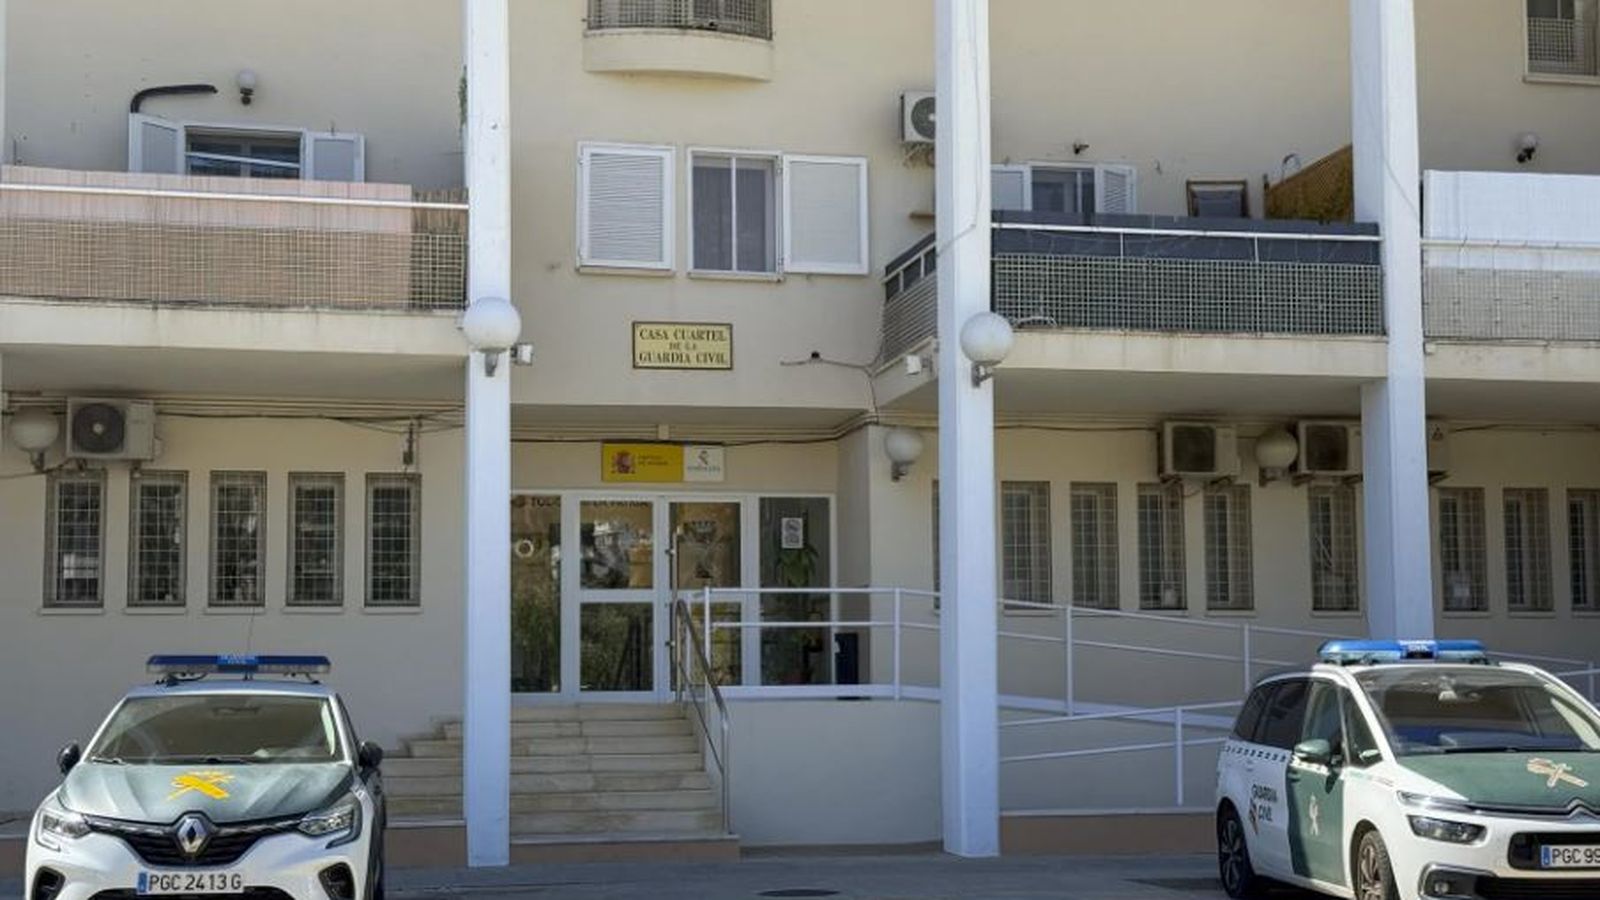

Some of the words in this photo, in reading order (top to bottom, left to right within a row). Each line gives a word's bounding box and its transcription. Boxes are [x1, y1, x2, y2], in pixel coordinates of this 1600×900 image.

[640, 328, 669, 340] CASA
[674, 328, 727, 341] CUARTEL
[669, 342, 681, 350] DE
[639, 352, 691, 363] GUARDIA
[696, 353, 726, 364] CIVIL
[1552, 848, 1581, 864] PGC
[149, 874, 181, 891] PGC
[231, 873, 242, 890] G
